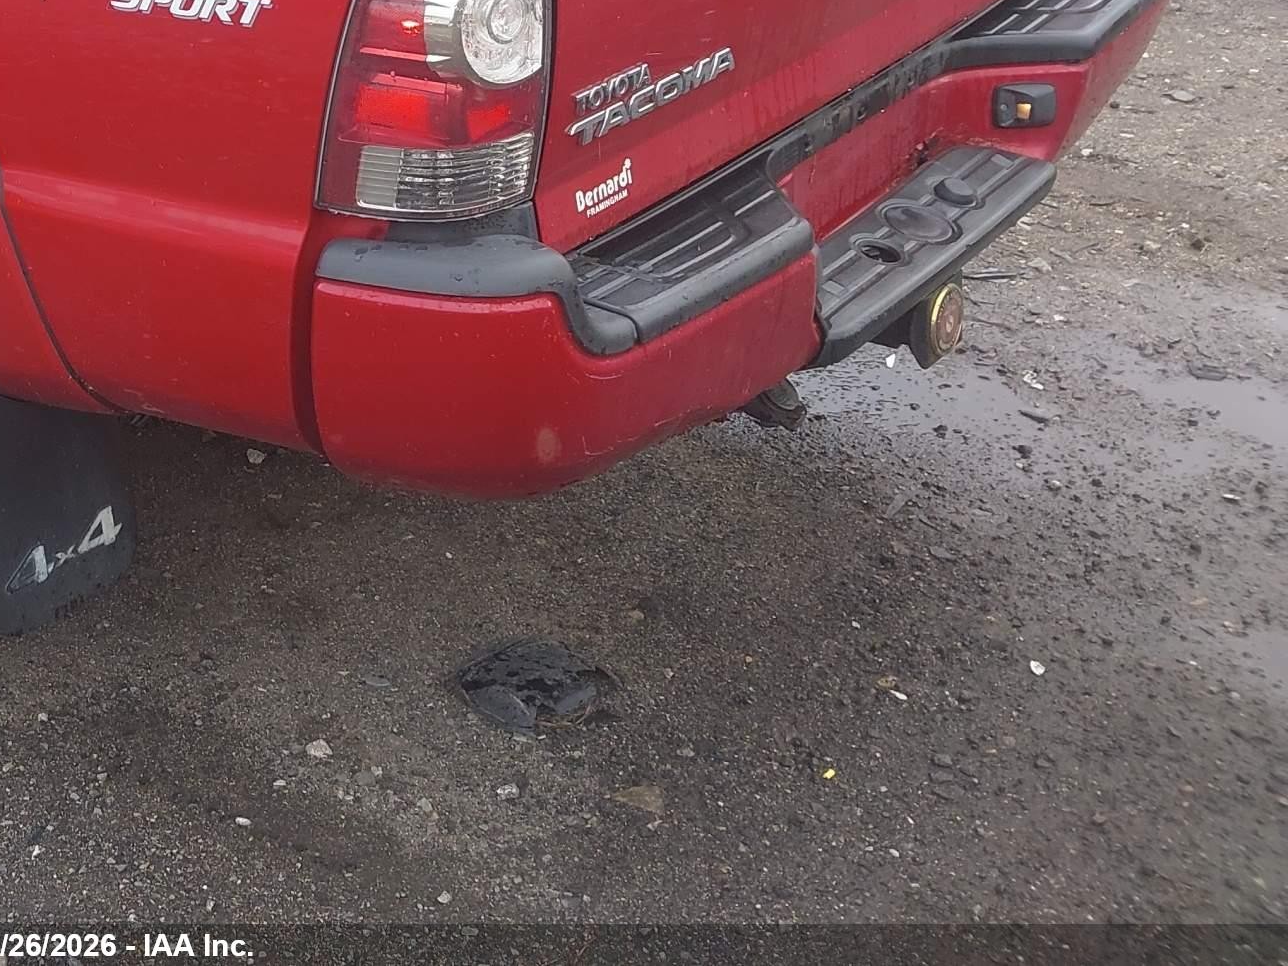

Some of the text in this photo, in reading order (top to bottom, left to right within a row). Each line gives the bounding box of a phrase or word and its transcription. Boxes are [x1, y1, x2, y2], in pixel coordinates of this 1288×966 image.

[567, 48, 735, 146] TACOMA
[572, 63, 652, 115] TOYOTA
[575, 158, 633, 213] Bernardi
[586, 189, 628, 218] FRAMINGHAM
[5, 505, 123, 594] 4x4
